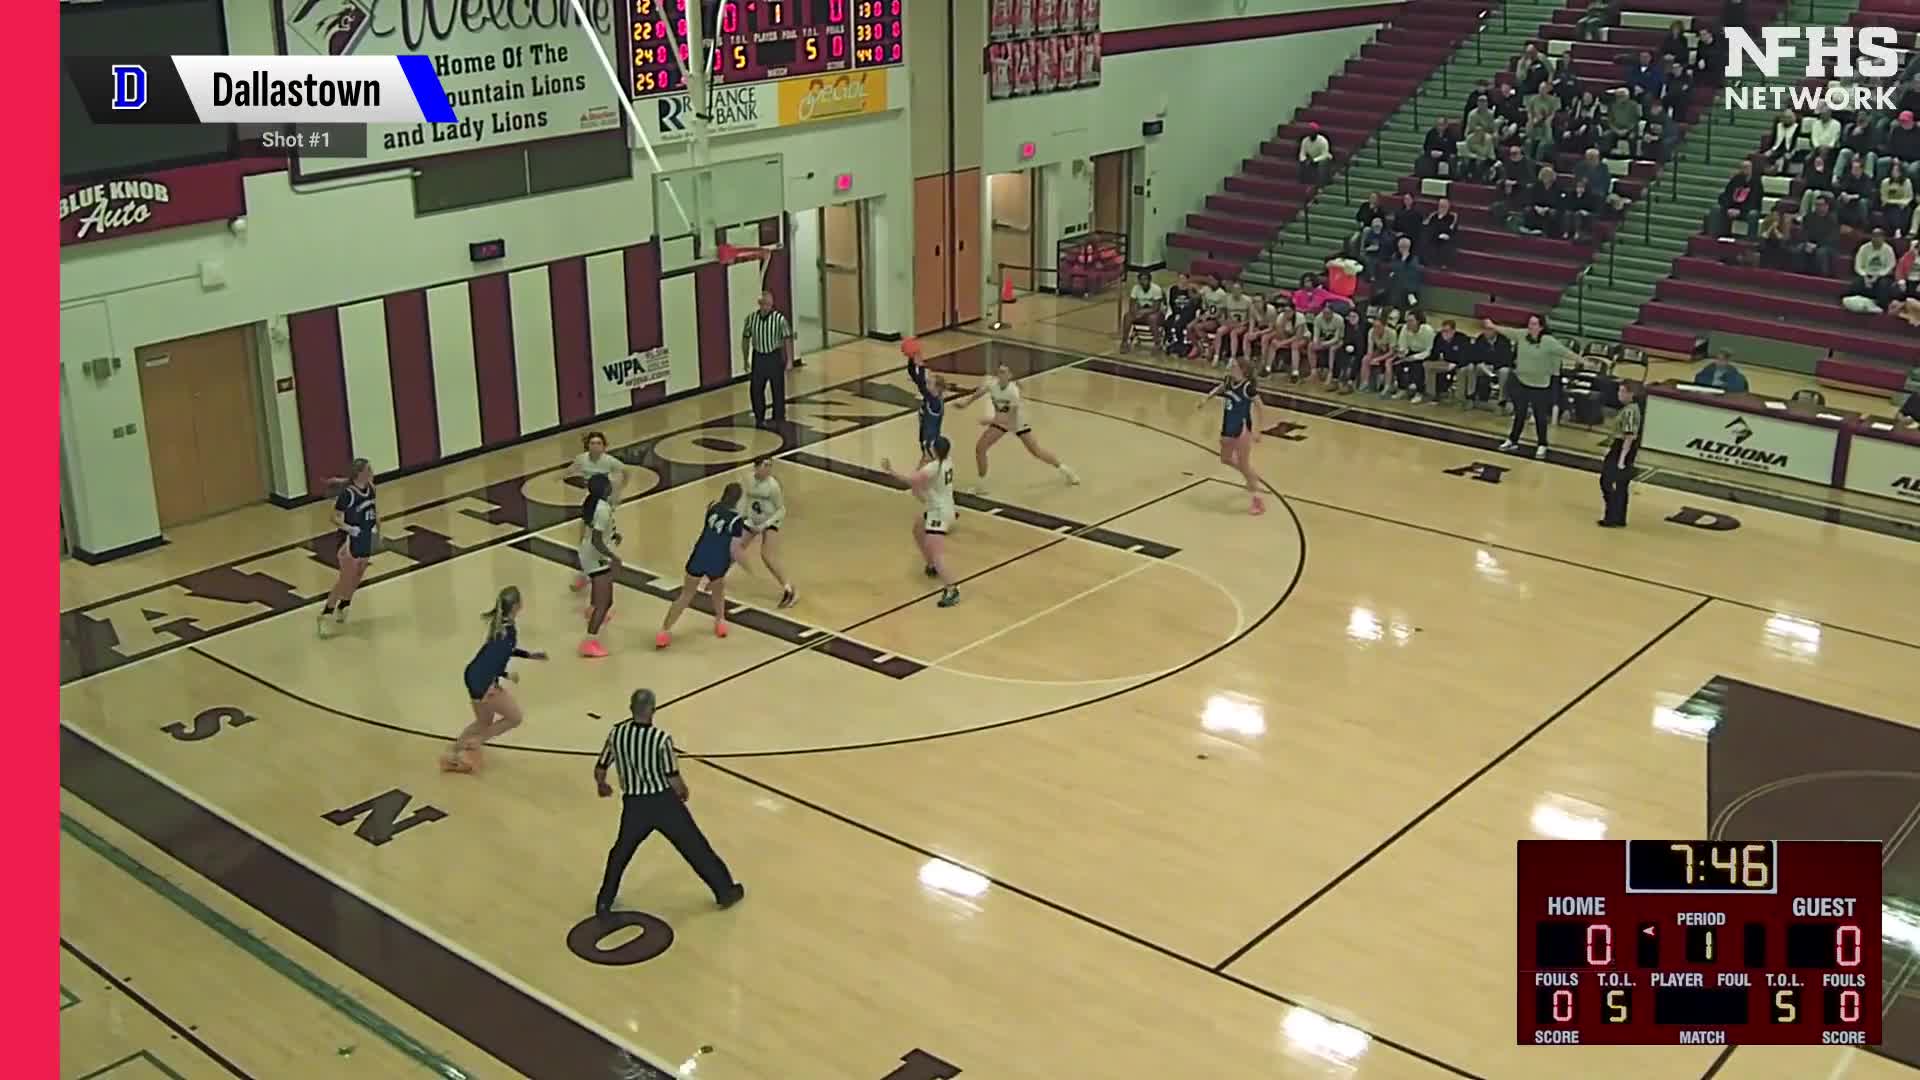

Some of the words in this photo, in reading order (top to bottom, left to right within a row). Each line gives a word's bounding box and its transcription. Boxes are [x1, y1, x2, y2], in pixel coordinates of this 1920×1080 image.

[858, 2, 871, 18] 13
[634, 22, 652, 40] 22
[857, 24, 872, 42] 33
[434, 54, 496, 77] Home
[502, 46, 522, 70] Of
[530, 44, 569, 65] The
[635, 48, 653, 66] 24
[734, 46, 746, 68] 5
[806, 38, 817, 60] 5
[856, 48, 872, 62] 44
[446, 80, 524, 108] ountain
[531, 74, 586, 97] Lions
[636, 72, 654, 91] 25
[716, 104, 758, 124] BANK
[384, 124, 424, 150] and
[432, 119, 484, 145] Lady
[492, 110, 548, 134] Lions
[60, 184, 104, 218] BLUE
[109, 181, 169, 202] KNOB
[77, 198, 152, 238] Auto
[602, 358, 646, 385] WJPA
[1686, 438, 1789, 468] ALTOONA
